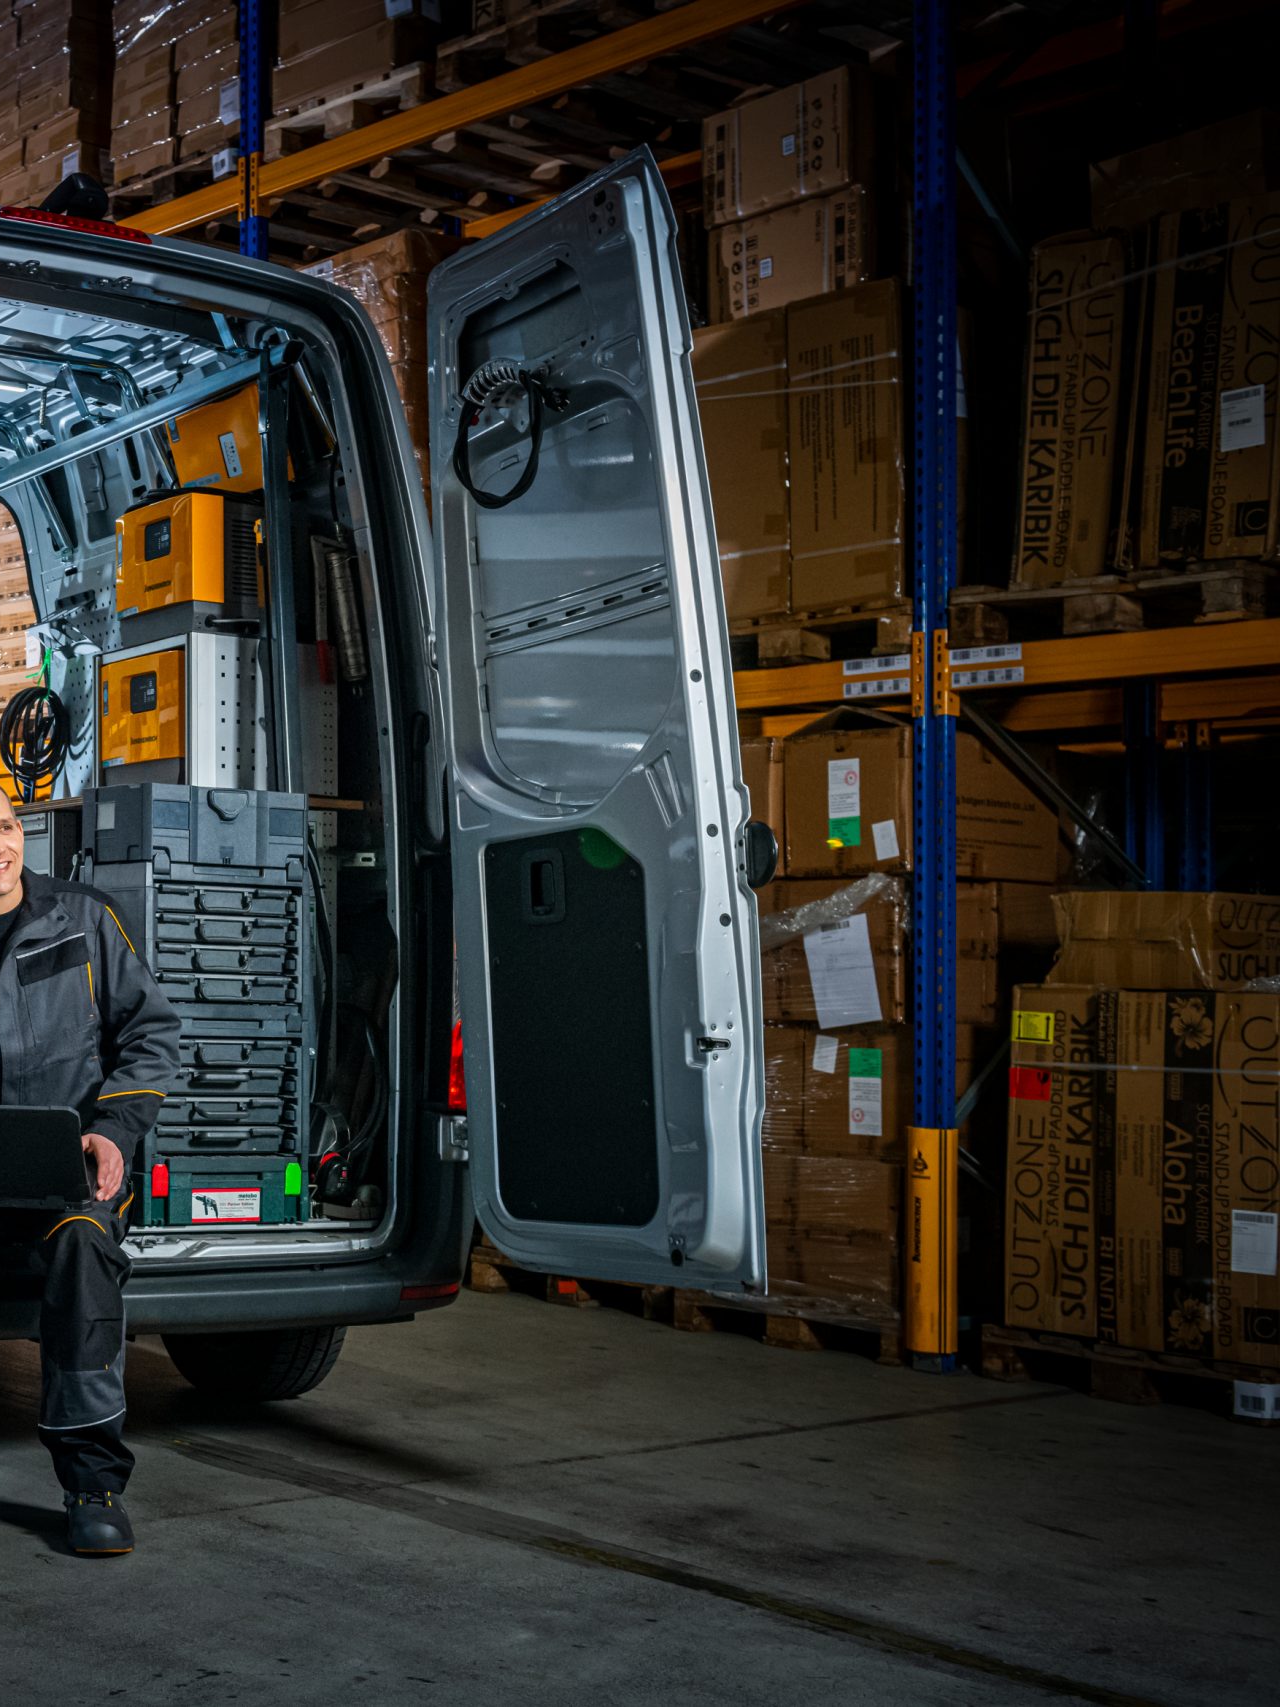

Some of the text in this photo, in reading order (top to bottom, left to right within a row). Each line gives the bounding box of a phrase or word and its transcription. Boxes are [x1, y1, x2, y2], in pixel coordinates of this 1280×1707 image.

[1022, 268, 1063, 566] SUCH DIE KARIBIK
[1165, 303, 1204, 468] BeachLife
[1196, 312, 1220, 452] SUCH DIE KARIBIK
[1010, 1113, 1046, 1312] OUTZONE
[1045, 1143, 1062, 1226] STAND-UP
[1060, 1013, 1097, 1320] SUCH DIE KARIBIK
[1163, 1119, 1194, 1226] Aloha
[1194, 1103, 1211, 1246] SUCH DIE KARIBIK
[1214, 1121, 1233, 1348] STAND-UP PADDLE-BOARD
